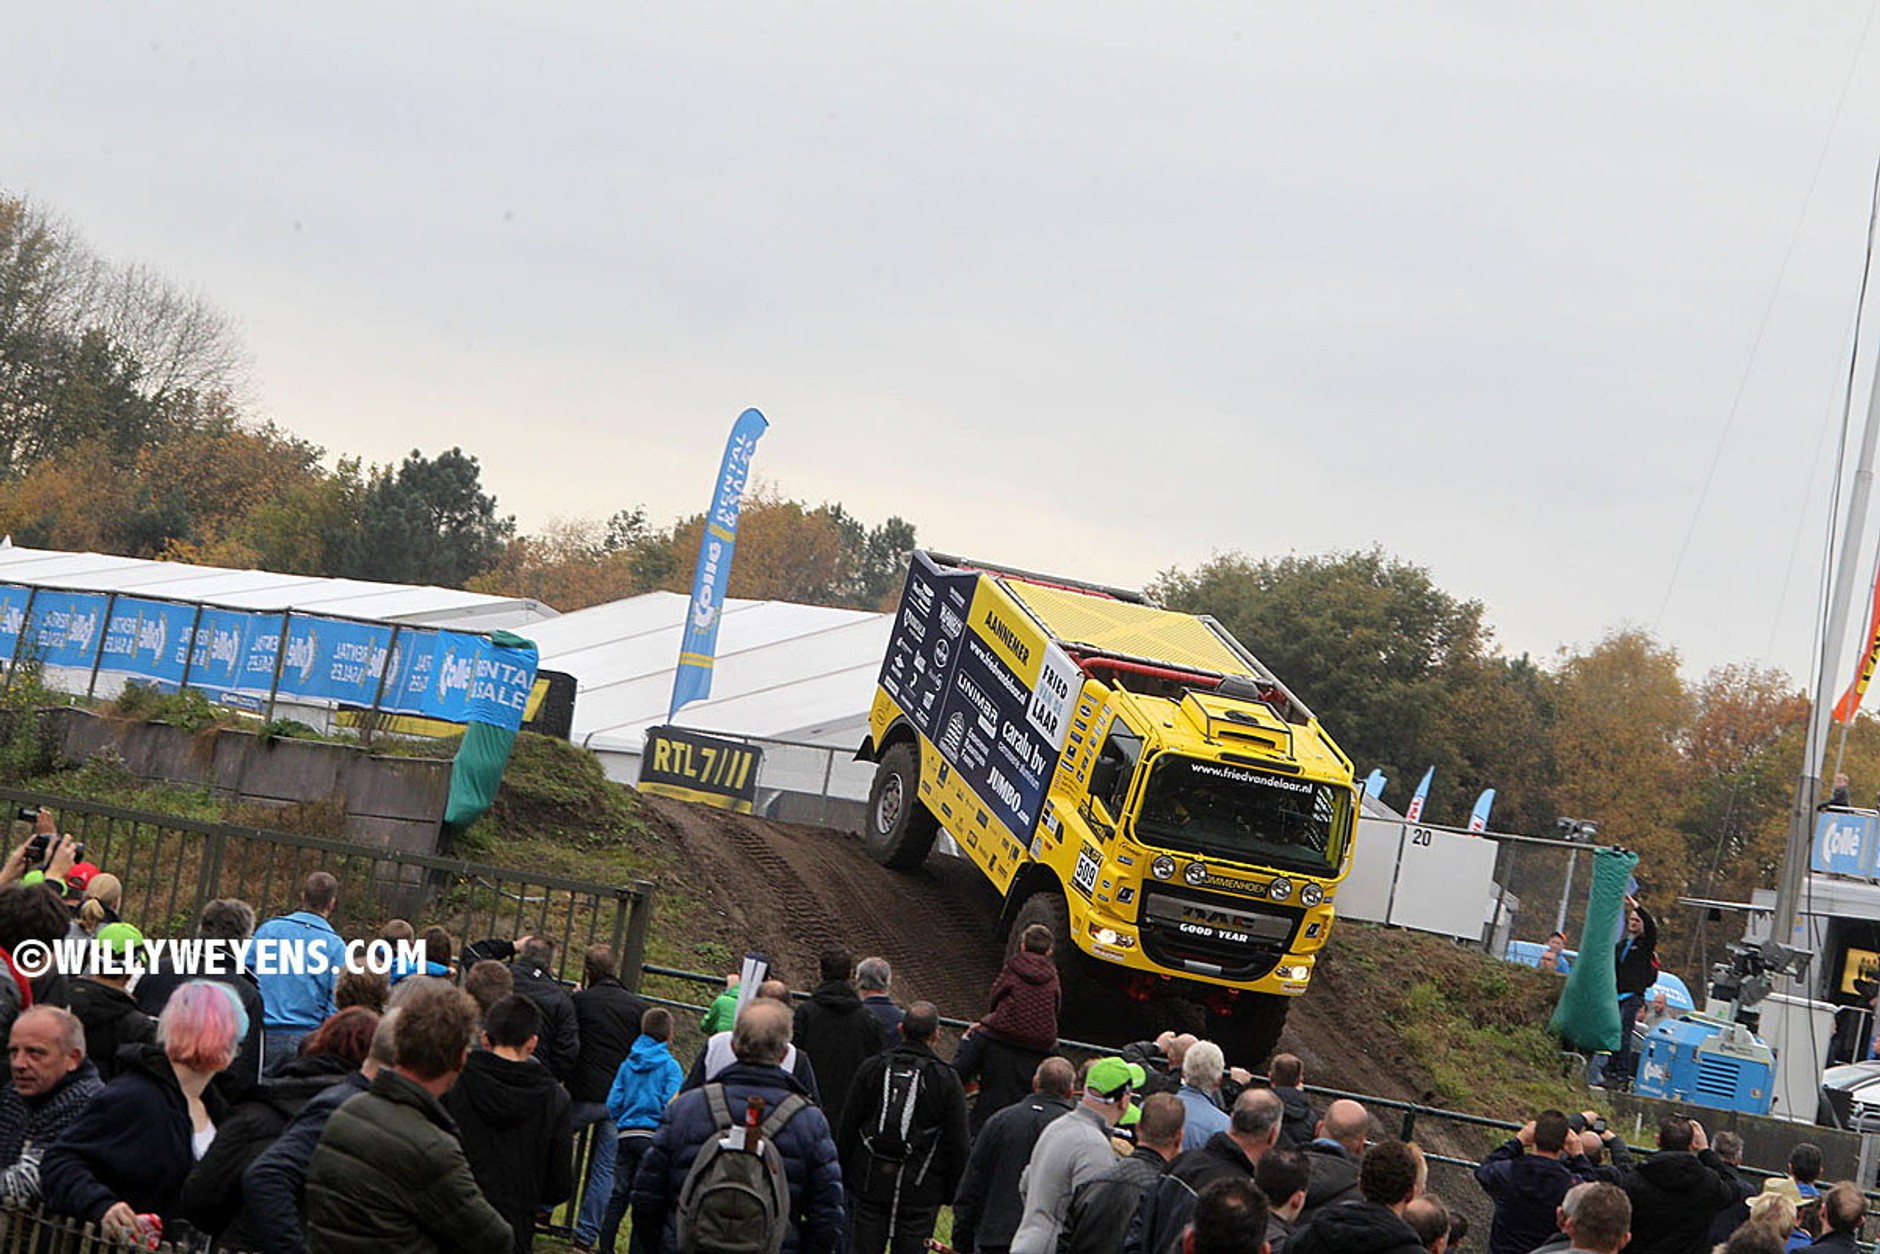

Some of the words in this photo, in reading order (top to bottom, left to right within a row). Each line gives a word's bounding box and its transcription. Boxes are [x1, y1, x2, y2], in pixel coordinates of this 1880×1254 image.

[984, 610, 1030, 667] AANNEMER
[1042, 664, 1068, 700] FRIED
[1031, 697, 1058, 738] LAAR
[1190, 762, 1313, 795] www.friedvandelaar.nl
[1412, 828, 1432, 847] 20
[1076, 857, 1098, 888] 509
[1179, 922, 1213, 937] GOOD
[1218, 929, 1249, 943] YEAR
